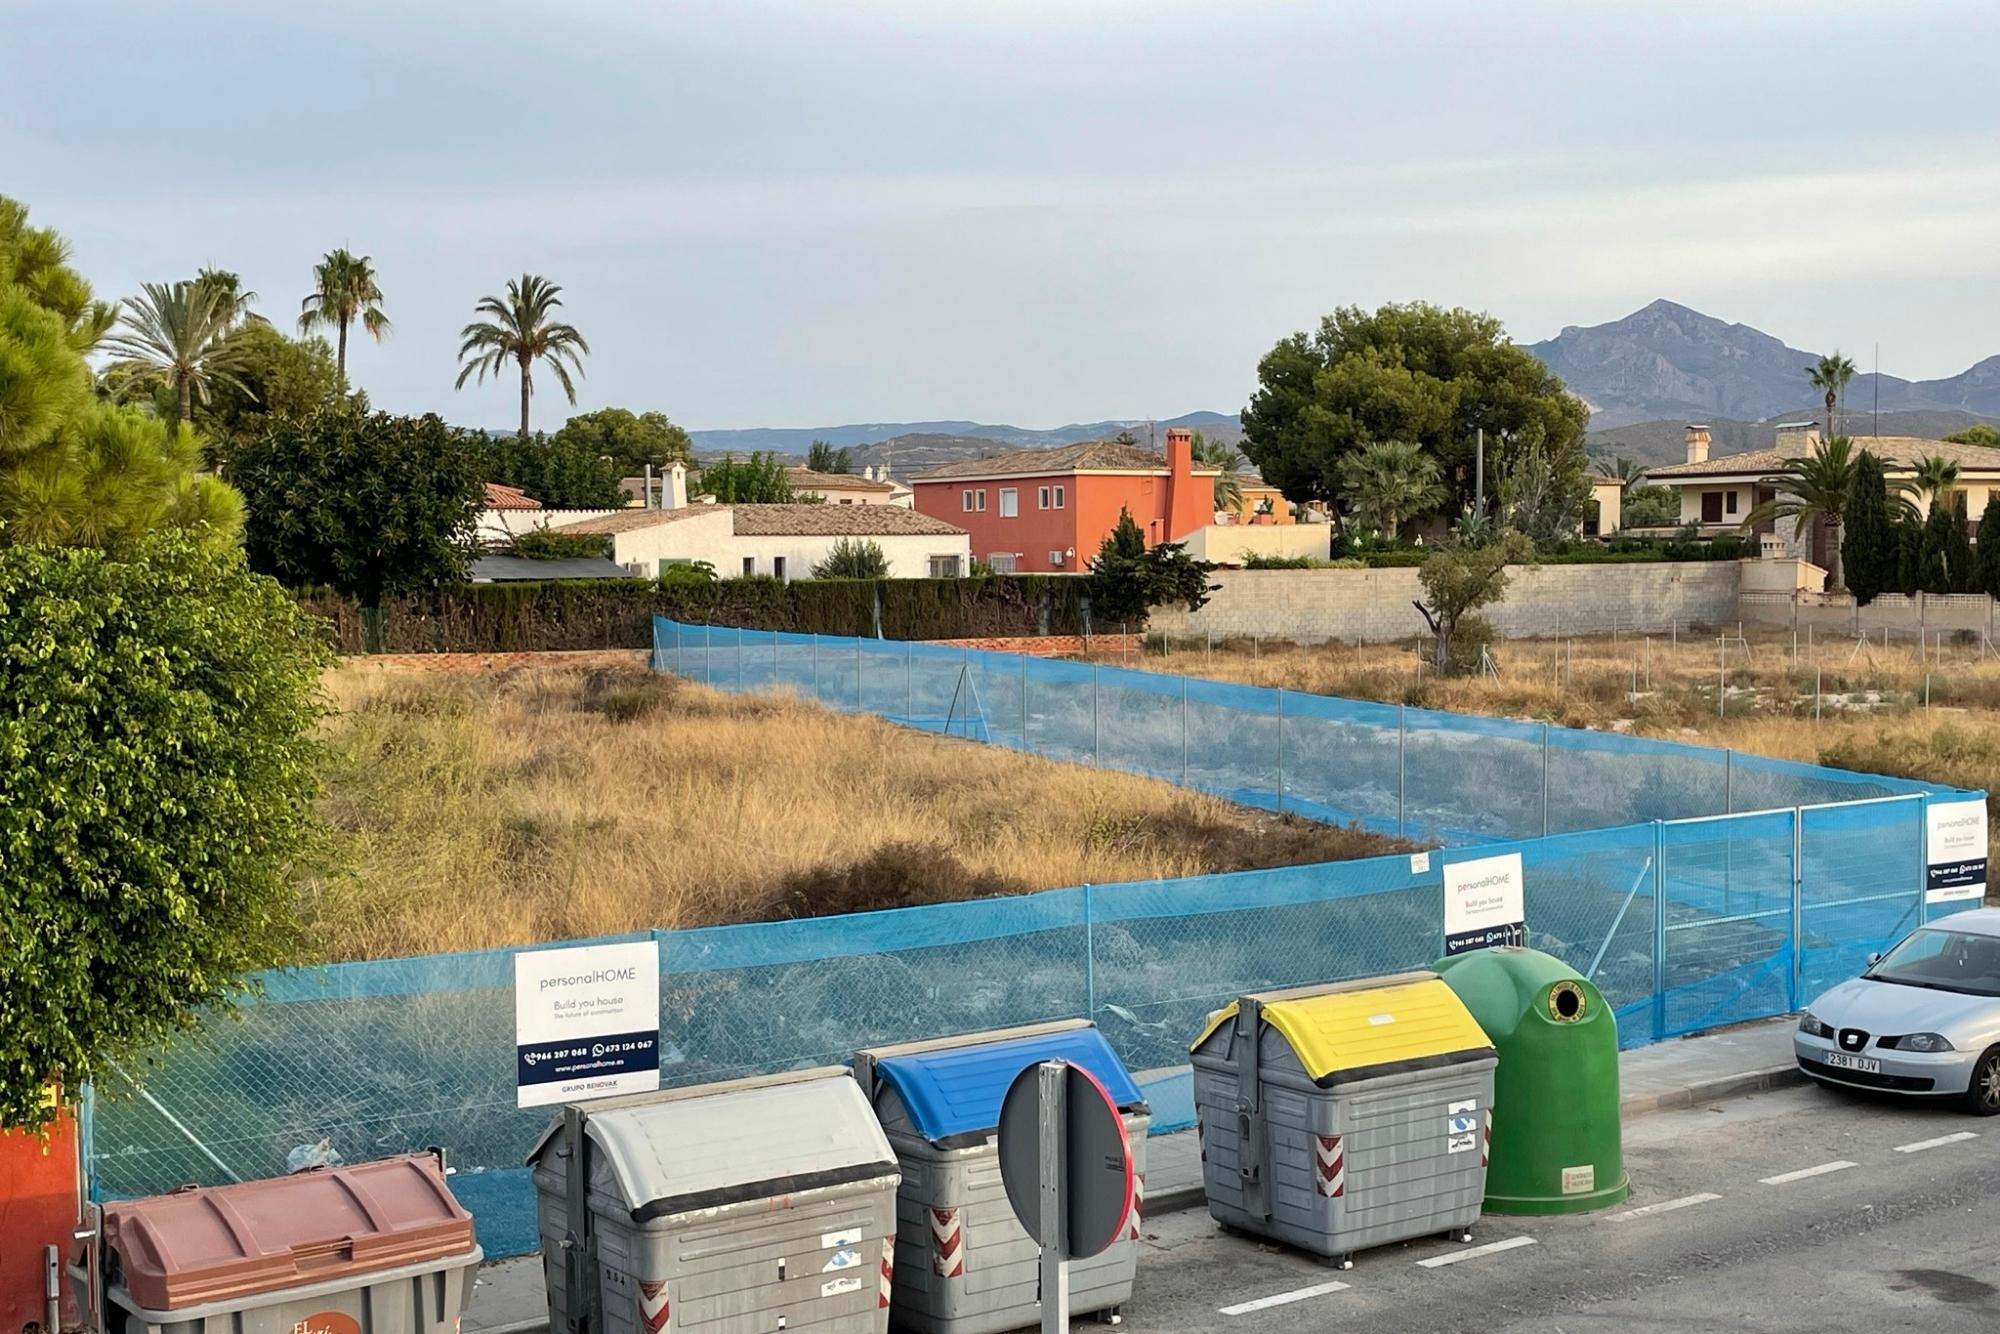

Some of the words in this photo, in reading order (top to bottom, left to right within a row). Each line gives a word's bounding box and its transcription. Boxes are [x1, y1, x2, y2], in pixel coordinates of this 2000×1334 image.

[1458, 873, 1509, 894] personalHOME
[540, 967, 636, 992] personalHOME
[554, 1000, 576, 1010] Build
[578, 1000, 595, 1010] you
[597, 996, 623, 1006] house
[537, 1051, 552, 1061] 966
[606, 1044, 619, 1053] 673
[622, 1042, 635, 1051] 124
[637, 1040, 653, 1049] 067
[555, 1060, 625, 1073] www.personalhome.es
[1830, 1053, 1853, 1067] 2381
[1858, 1058, 1877, 1072] DJV
[562, 1084, 585, 1093] GRUPO
